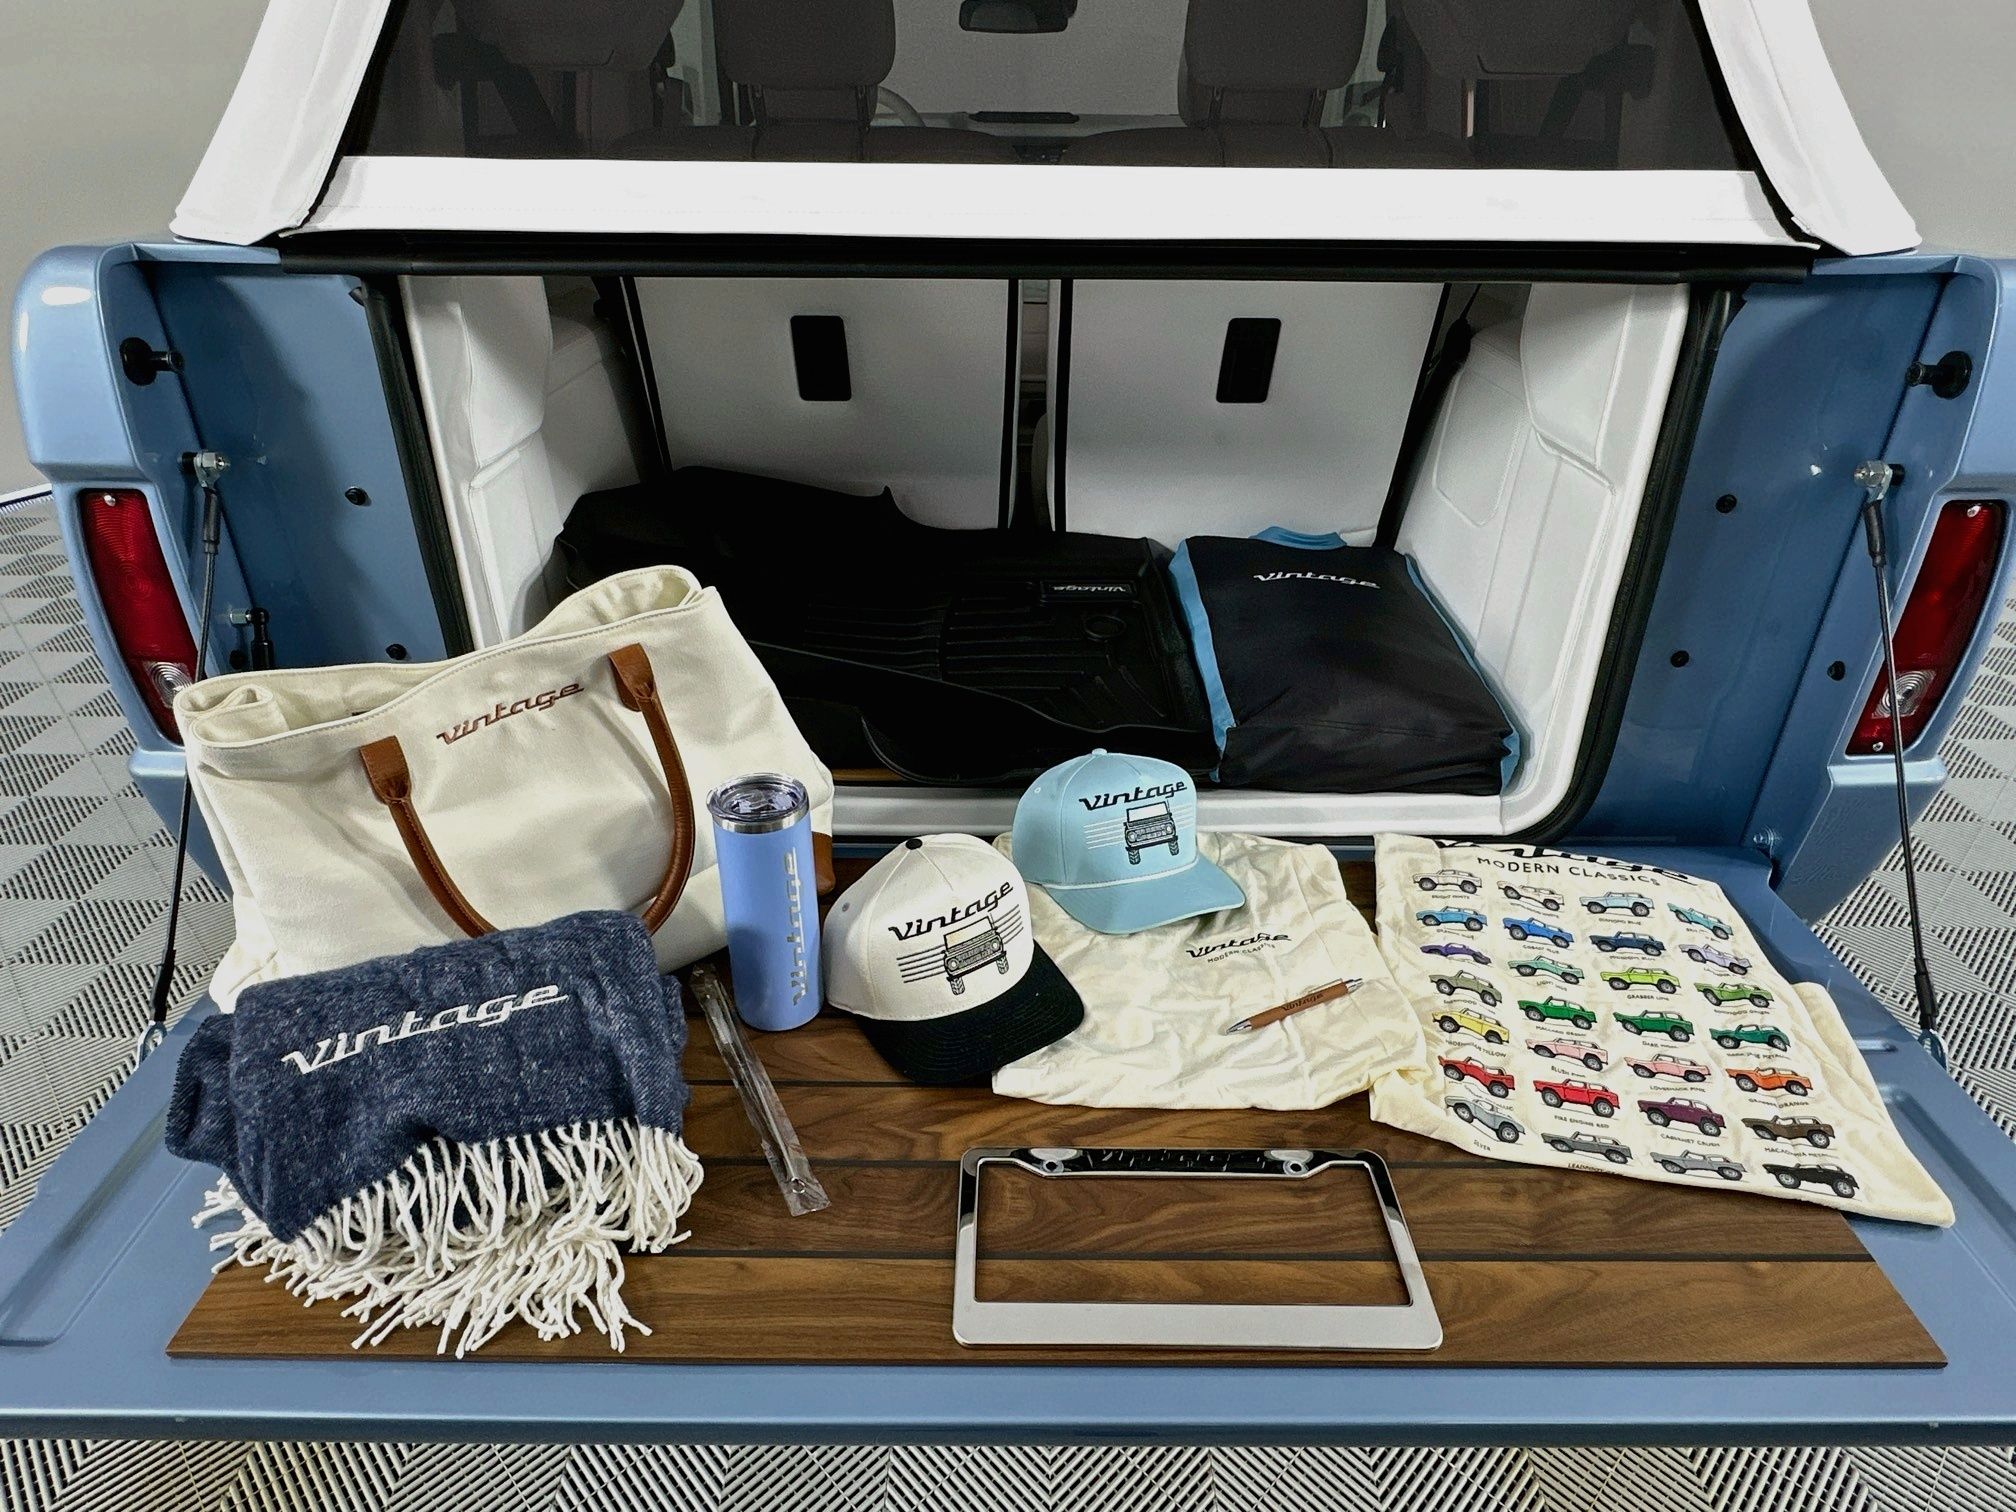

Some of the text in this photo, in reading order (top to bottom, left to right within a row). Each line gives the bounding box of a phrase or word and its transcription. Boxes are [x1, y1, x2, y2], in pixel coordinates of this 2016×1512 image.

[1253, 571, 1381, 589] Vintage
[436, 683, 585, 745] Vintage
[1079, 781, 1188, 811] Vintage
[1477, 857, 1560, 875] MODERN
[1569, 866, 1660, 886] CLASSICS
[783, 847, 807, 1006] Vintage
[888, 881, 1014, 941] Vintage
[1208, 950, 1240, 963] MODERN
[280, 984, 569, 1075] Vintage
